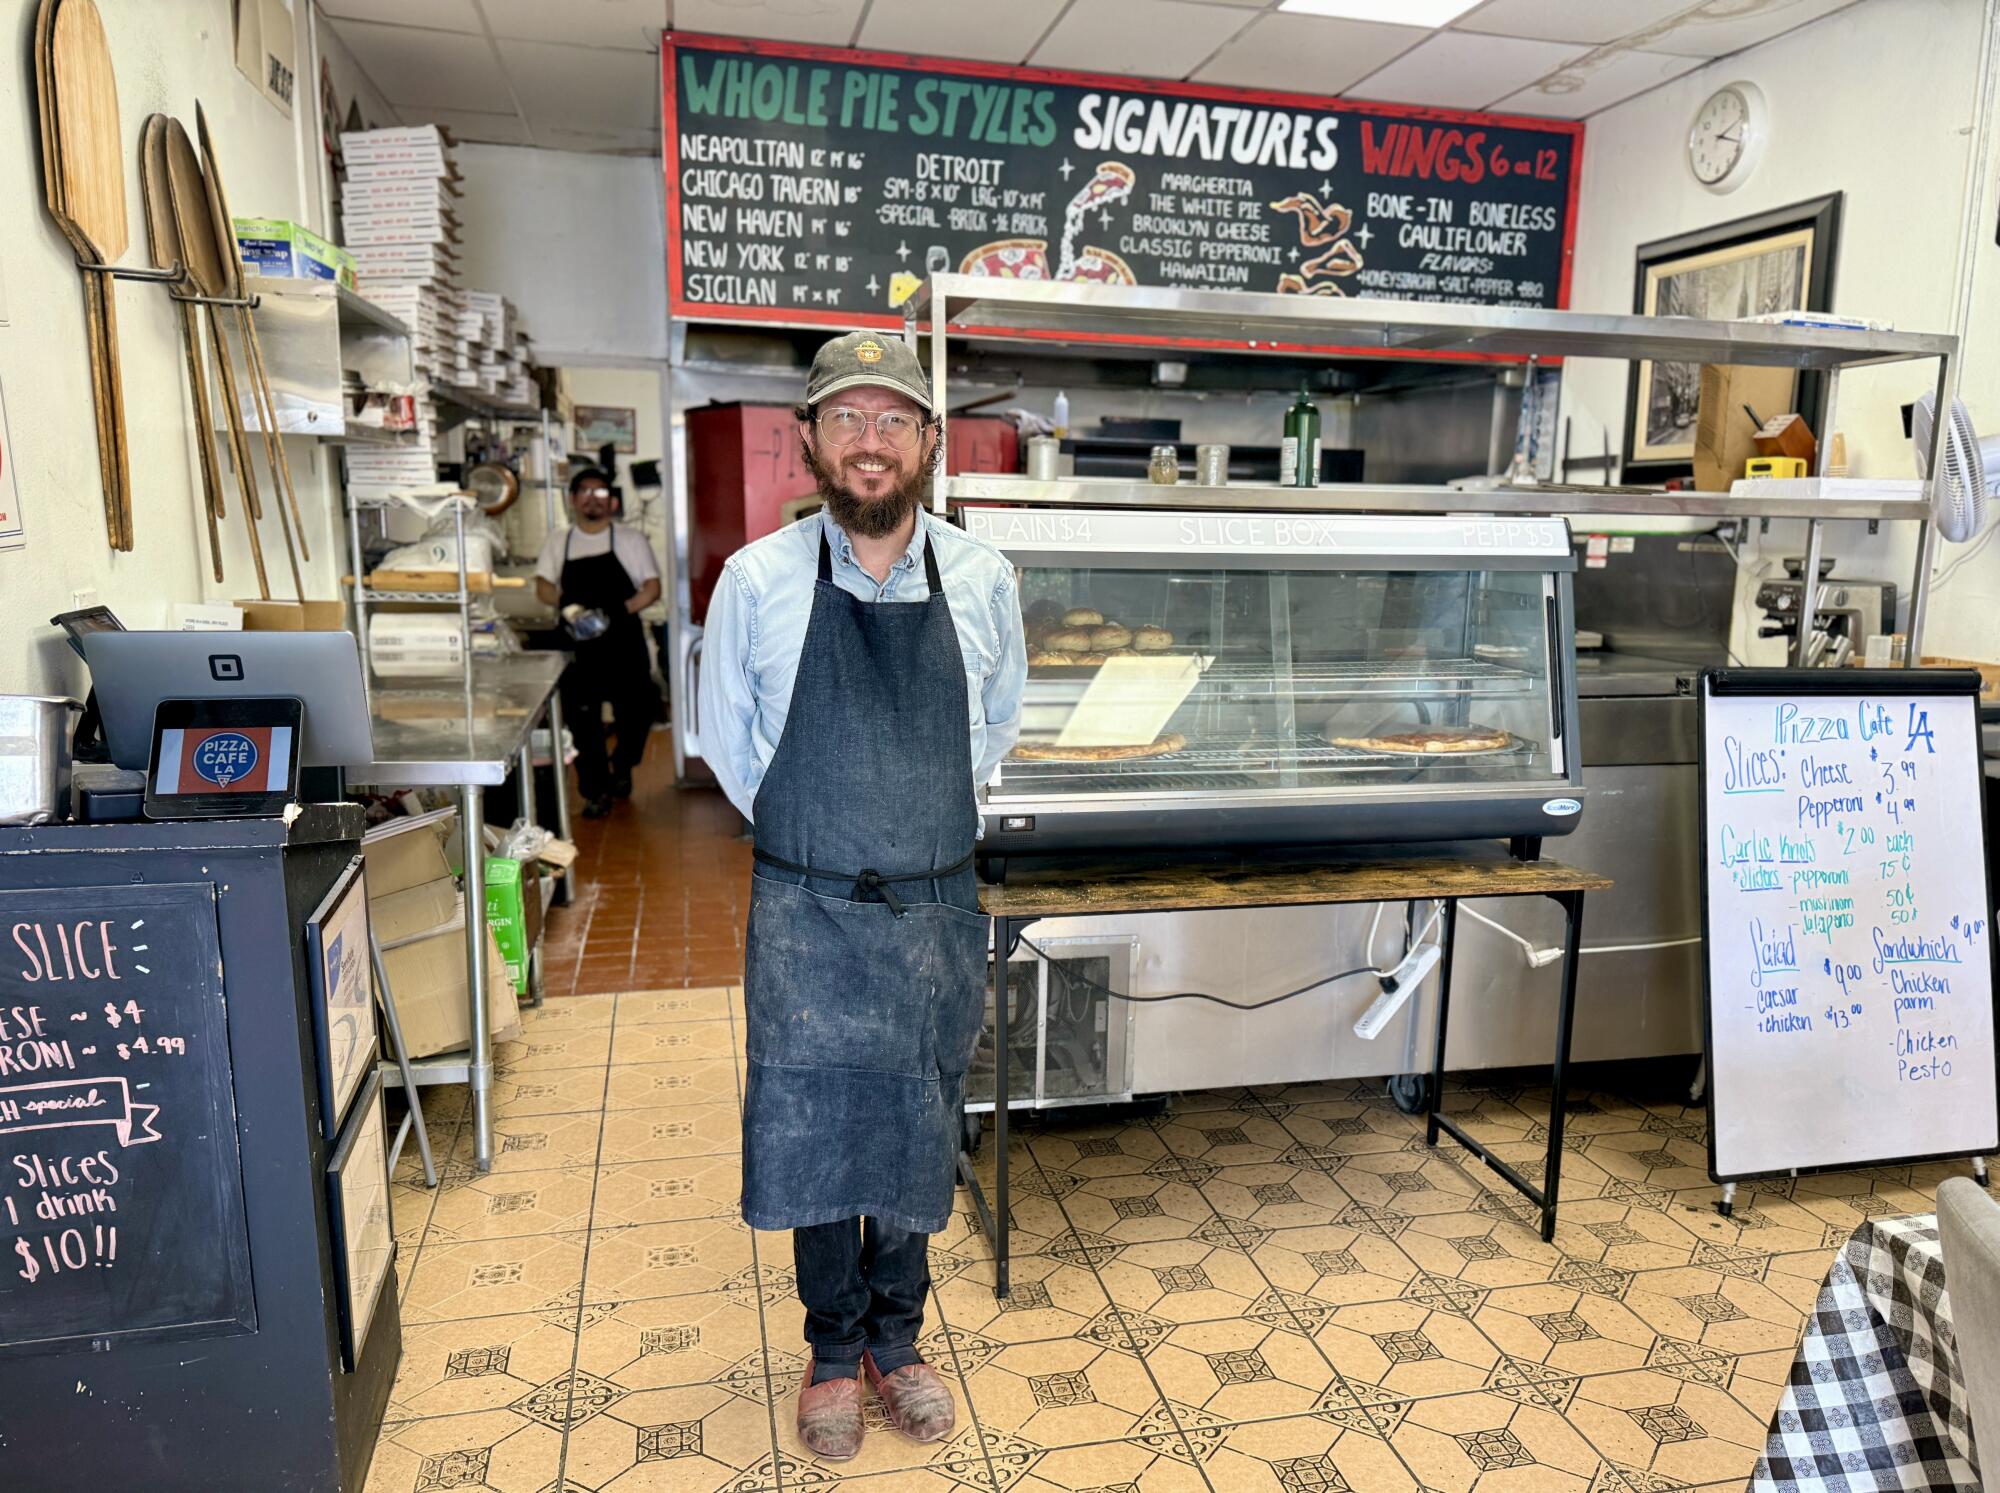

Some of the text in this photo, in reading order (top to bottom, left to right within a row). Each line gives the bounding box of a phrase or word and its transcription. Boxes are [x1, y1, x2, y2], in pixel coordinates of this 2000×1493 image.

[681, 54, 1057, 147] WHOLE PIE STYLES
[1073, 93, 1338, 172] SIGNATURES
[680, 133, 805, 169] NEAPOLITAN
[1360, 120, 1486, 184] WINGS
[1490, 144, 1509, 177] 6
[1535, 149, 1557, 180] 12
[916, 152, 1006, 187] DETROIT
[1161, 173, 1253, 196] MARGHERITA
[682, 168, 764, 201] CHICAGO
[770, 174, 840, 207] TAVERN
[683, 203, 728, 233] NEW
[736, 207, 803, 238] HAVEN
[1148, 193, 1262, 220] THE WHITE PIE
[1367, 192, 1556, 231] BONE-IN BONELESS
[1132, 213, 1271, 242] BROOKLYN CHEESE
[1399, 223, 1528, 256] CAULIFLOWER
[684, 239, 728, 268] NEW
[736, 242, 785, 272] YORK
[1120, 236, 1282, 265] CLASSIC PEPPERONI
[1160, 261, 1249, 283] HAWAIIAN
[686, 273, 777, 306] SICILAN
[1179, 517, 1337, 547] SLICE BOX
[1775, 702, 1849, 744] Pizza
[1904, 702, 1936, 753] LA
[203, 752, 248, 764] CAFE
[204, 740, 249, 752] PIZZA
[214, 765, 235, 774] LA
[1724, 735, 1788, 791] Slices:
[1721, 823, 1774, 868] Garlic
[1886, 830, 1914, 852] each
[12, 920, 123, 982] SLICE
[1891, 969, 1952, 996] Chicken
[104, 1000, 146, 1029] $4
[116, 1036, 186, 1060] $4.99
[1896, 1029, 1960, 1057] Chicken
[1898, 1056, 1953, 1081] Pesto
[22, 1088, 107, 1116] special
[13, 1151, 120, 1189] Slices
[6, 1187, 118, 1226] 1 drink
[14, 1225, 118, 1284] $10!!
